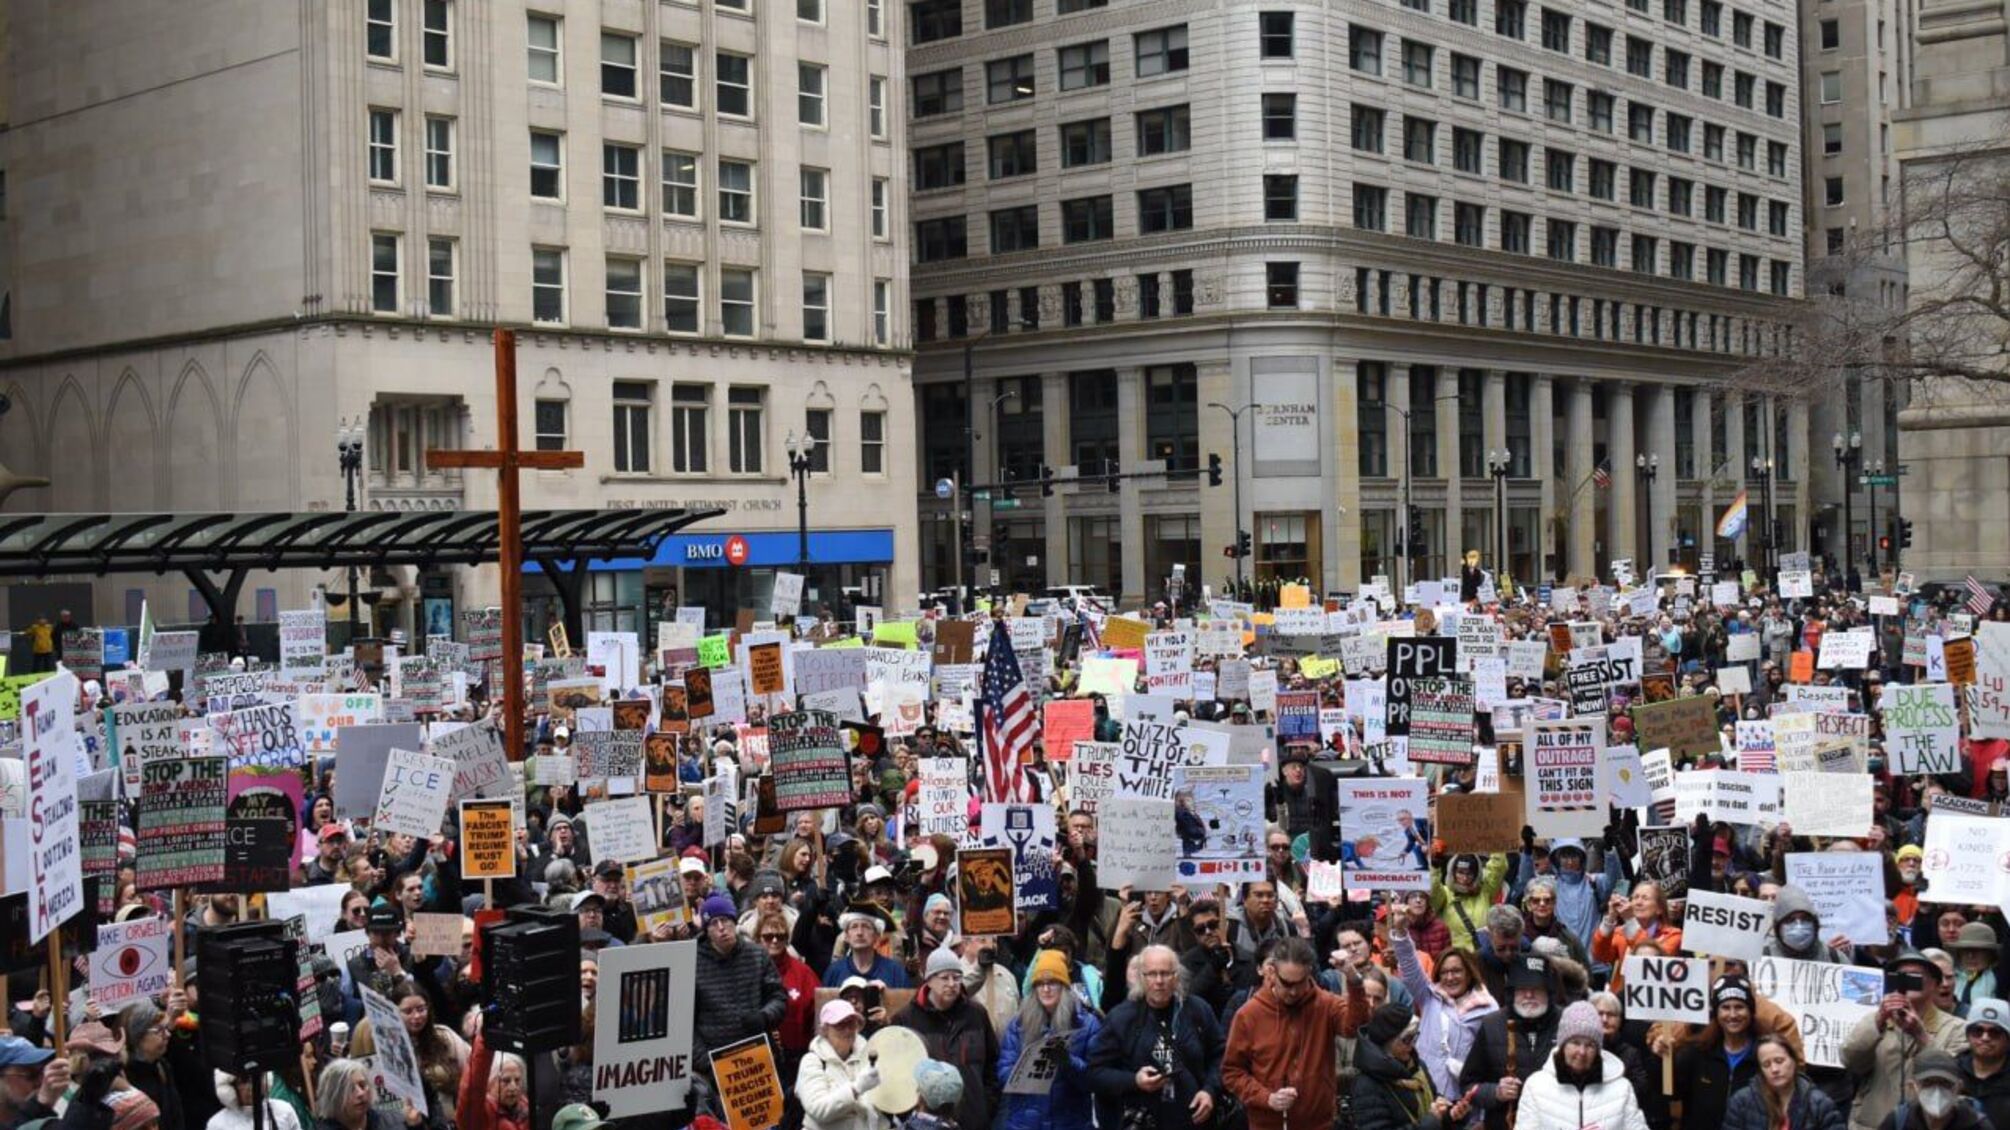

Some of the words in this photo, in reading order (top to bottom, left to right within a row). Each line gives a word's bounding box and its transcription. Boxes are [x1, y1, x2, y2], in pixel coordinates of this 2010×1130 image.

[606, 500, 635, 511] FIRST
[641, 500, 679, 511] UNITED
[684, 500, 738, 511] METHODIST
[743, 499, 782, 511] CHURCH
[687, 543, 723, 560] BMO
[1153, 647, 1187, 659] TRUMP
[1396, 643, 1454, 676] PPL
[1160, 660, 1178, 672] IN
[1149, 672, 1191, 687] CONTEMPT
[1570, 669, 1598, 686] FREE
[266, 683, 300, 695] Hands
[1414, 680, 1446, 695] STOP
[1451, 681, 1473, 696] THE
[1797, 687, 1845, 702] Respect
[346, 697, 375, 710] OFF
[1896, 686, 1937, 709] DUE
[114, 707, 179, 727] EDUCATION
[242, 703, 292, 733] HANDS
[1280, 705, 1316, 716] FASCISM
[1885, 705, 1954, 730] PROCESS
[327, 715, 355, 728] OUR
[769, 712, 809, 731] STOP
[813, 710, 836, 727] THE
[1815, 712, 1867, 736] RESPECT
[141, 729, 155, 744] IS
[158, 728, 175, 743] AT
[262, 730, 300, 752] OUR
[1124, 722, 1182, 745] NAZIS
[1536, 732, 1554, 746] ALL
[1558, 733, 1572, 745] OF
[1575, 732, 1592, 745] MY
[1899, 733, 1938, 750] THE
[141, 744, 178, 760] STEAK
[1073, 743, 1120, 762] TRUMP
[1123, 738, 1159, 757] OUT
[1162, 741, 1186, 763] OF
[1537, 747, 1595, 766] OUTRAGE
[933, 757, 956, 771] TAX
[1123, 755, 1173, 781] THE
[1899, 745, 1955, 774] LAW
[143, 761, 184, 784] STOP
[190, 759, 225, 780] THE
[391, 764, 440, 790] ICE
[1077, 762, 1113, 778] LIES
[1536, 767, 1562, 778] CAN'T
[1564, 767, 1577, 778] FIT
[1579, 767, 1594, 777] ON
[142, 782, 171, 796] TRUMP
[175, 779, 225, 793] AGENDA!
[1119, 773, 1170, 800] WHITE
[1537, 778, 1563, 792] THIS
[1567, 778, 1594, 791] SIGN
[246, 795, 269, 808] MY
[926, 789, 957, 802] FUND
[1352, 790, 1376, 799] THIS
[1377, 790, 1387, 799] IS
[1389, 790, 1413, 799] NOT
[81, 803, 117, 820] THE
[932, 803, 956, 815] OUR
[1717, 800, 1731, 811] my
[1731, 799, 1749, 810] dad
[1758, 802, 1777, 813] did!
[1933, 795, 1986, 813] ACADEMIC
[477, 811, 497, 821] The
[919, 815, 968, 833] FUTURES
[191, 822, 226, 833] CRIMES
[464, 821, 509, 832] FASCIST
[469, 831, 506, 840] TRUMP
[467, 840, 509, 850] REGIME
[473, 851, 503, 861] MUST
[479, 861, 499, 871] GO!
[1353, 873, 1422, 884] DEMOCRACY!
[1015, 893, 1048, 908] BACK
[1686, 903, 1765, 933] RESIST
[99, 929, 120, 946] AKE
[125, 921, 166, 941] ORWELL
[1642, 957, 1689, 984] NO
[92, 982, 135, 1004] FICTION
[135, 973, 170, 994] AGAIN
[1790, 961, 1842, 1005] KINGS
[1627, 984, 1706, 1012] KING
[730, 1056, 754, 1069] The
[595, 1054, 688, 1091] IMAGINE
[725, 1063, 766, 1085] TRUMP
[725, 1073, 773, 1098] FASCIST
[730, 1086, 775, 1110] REGIME
[740, 1099, 772, 1120] MUST
[749, 1113, 769, 1128] GO!
